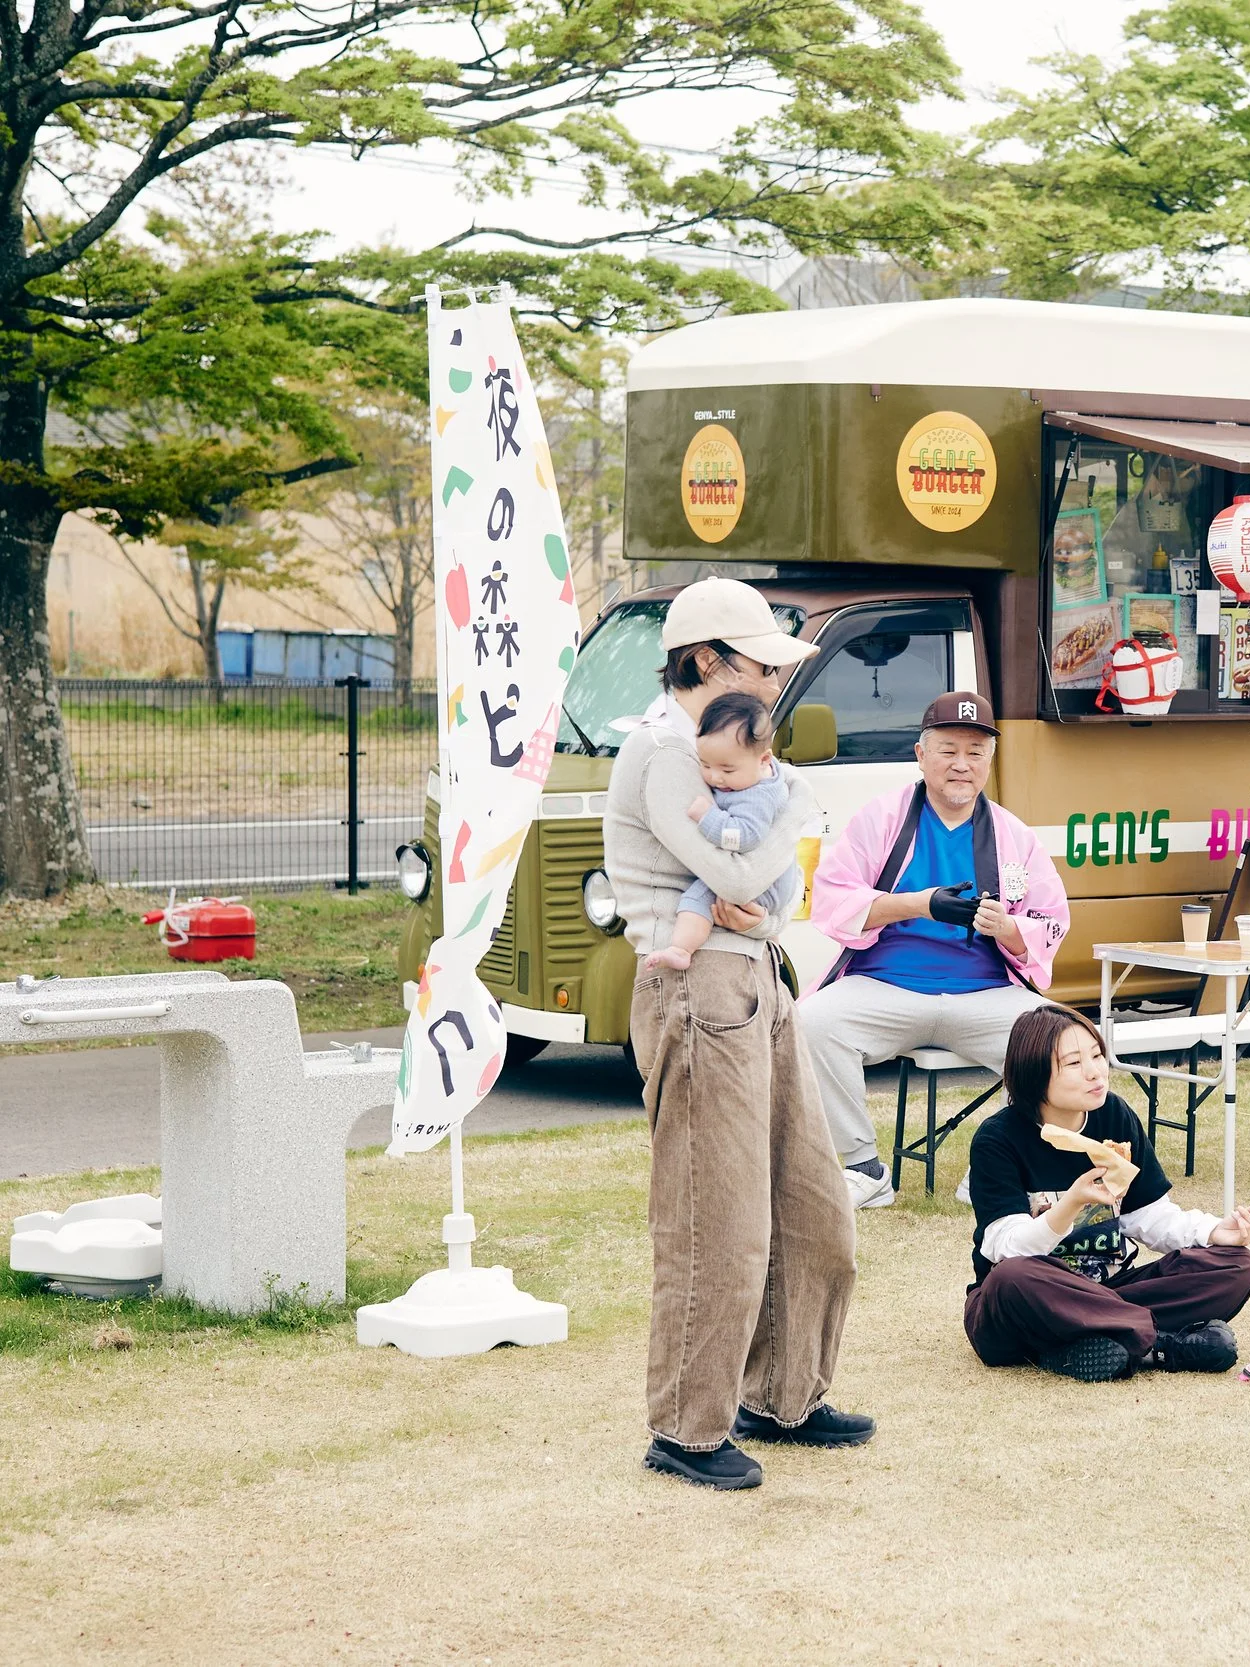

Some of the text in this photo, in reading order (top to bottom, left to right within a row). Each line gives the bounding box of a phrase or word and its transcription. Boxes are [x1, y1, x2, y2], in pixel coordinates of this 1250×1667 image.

[919, 447, 976, 473] GEN'S
[912, 470, 981, 494] BURGER
[690, 483, 736, 505] BURGER
[931, 505, 962, 517] SINCE 2024
[958, 701, 978, 721] 肉
[1066, 809, 1170, 868] GEN'S
